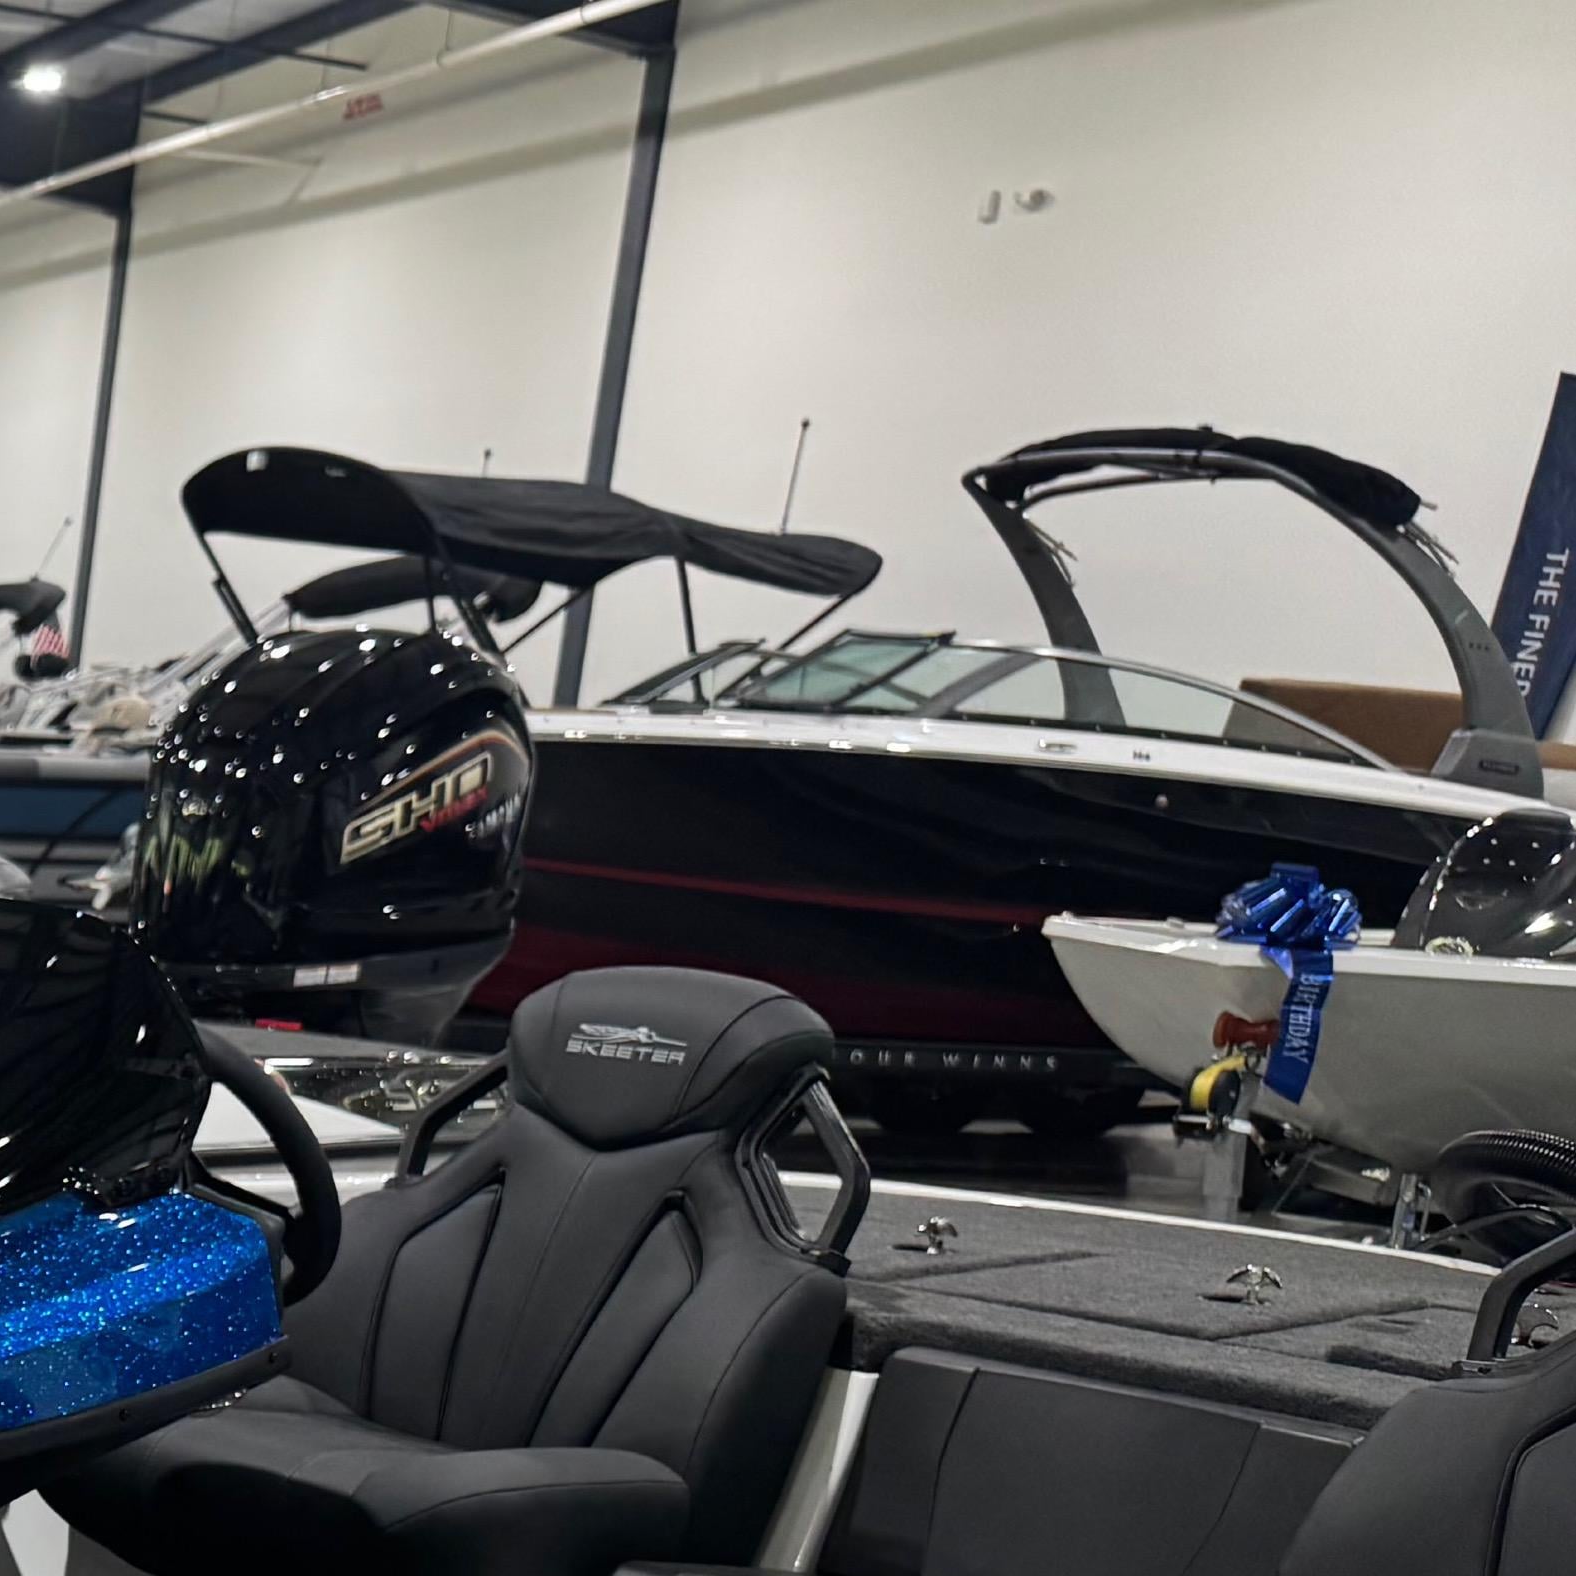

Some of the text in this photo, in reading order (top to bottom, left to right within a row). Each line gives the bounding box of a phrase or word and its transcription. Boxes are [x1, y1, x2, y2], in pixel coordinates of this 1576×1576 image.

[1533, 548, 1569, 607] THE
[1283, 973, 1323, 1064] BIRTHDAY
[566, 1039, 687, 1066] SKEETER
[850, 1048, 916, 1068] OUR
